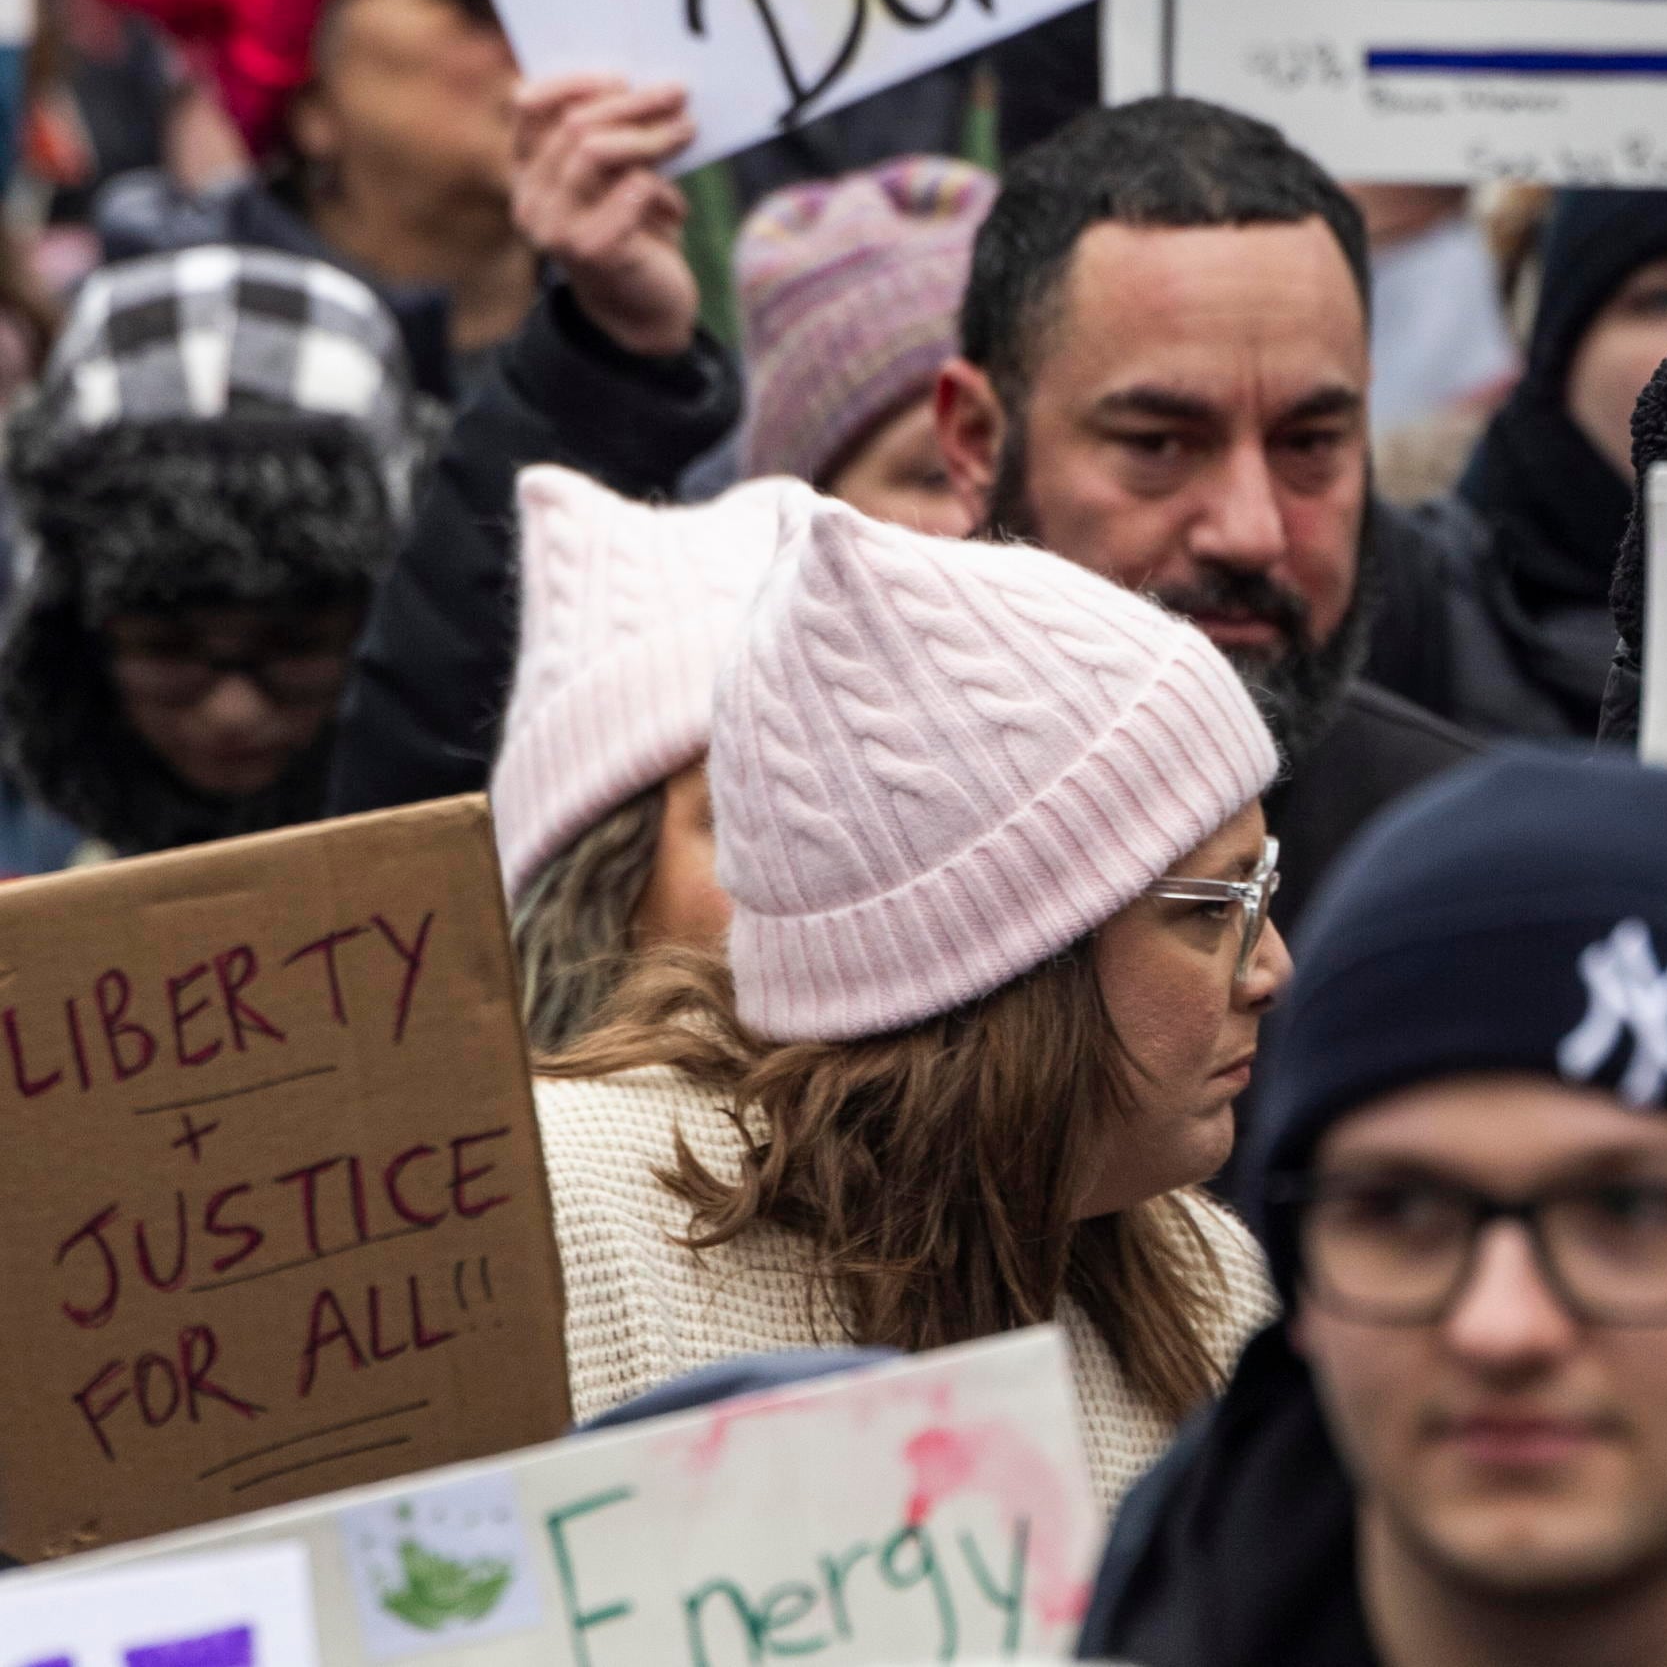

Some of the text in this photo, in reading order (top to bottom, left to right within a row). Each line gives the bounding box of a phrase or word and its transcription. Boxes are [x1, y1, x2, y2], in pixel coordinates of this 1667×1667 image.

[2, 910, 437, 1101] LIBERTY
[54, 1126, 514, 1332] JUSTICE
[72, 1324, 270, 1465] FOR
